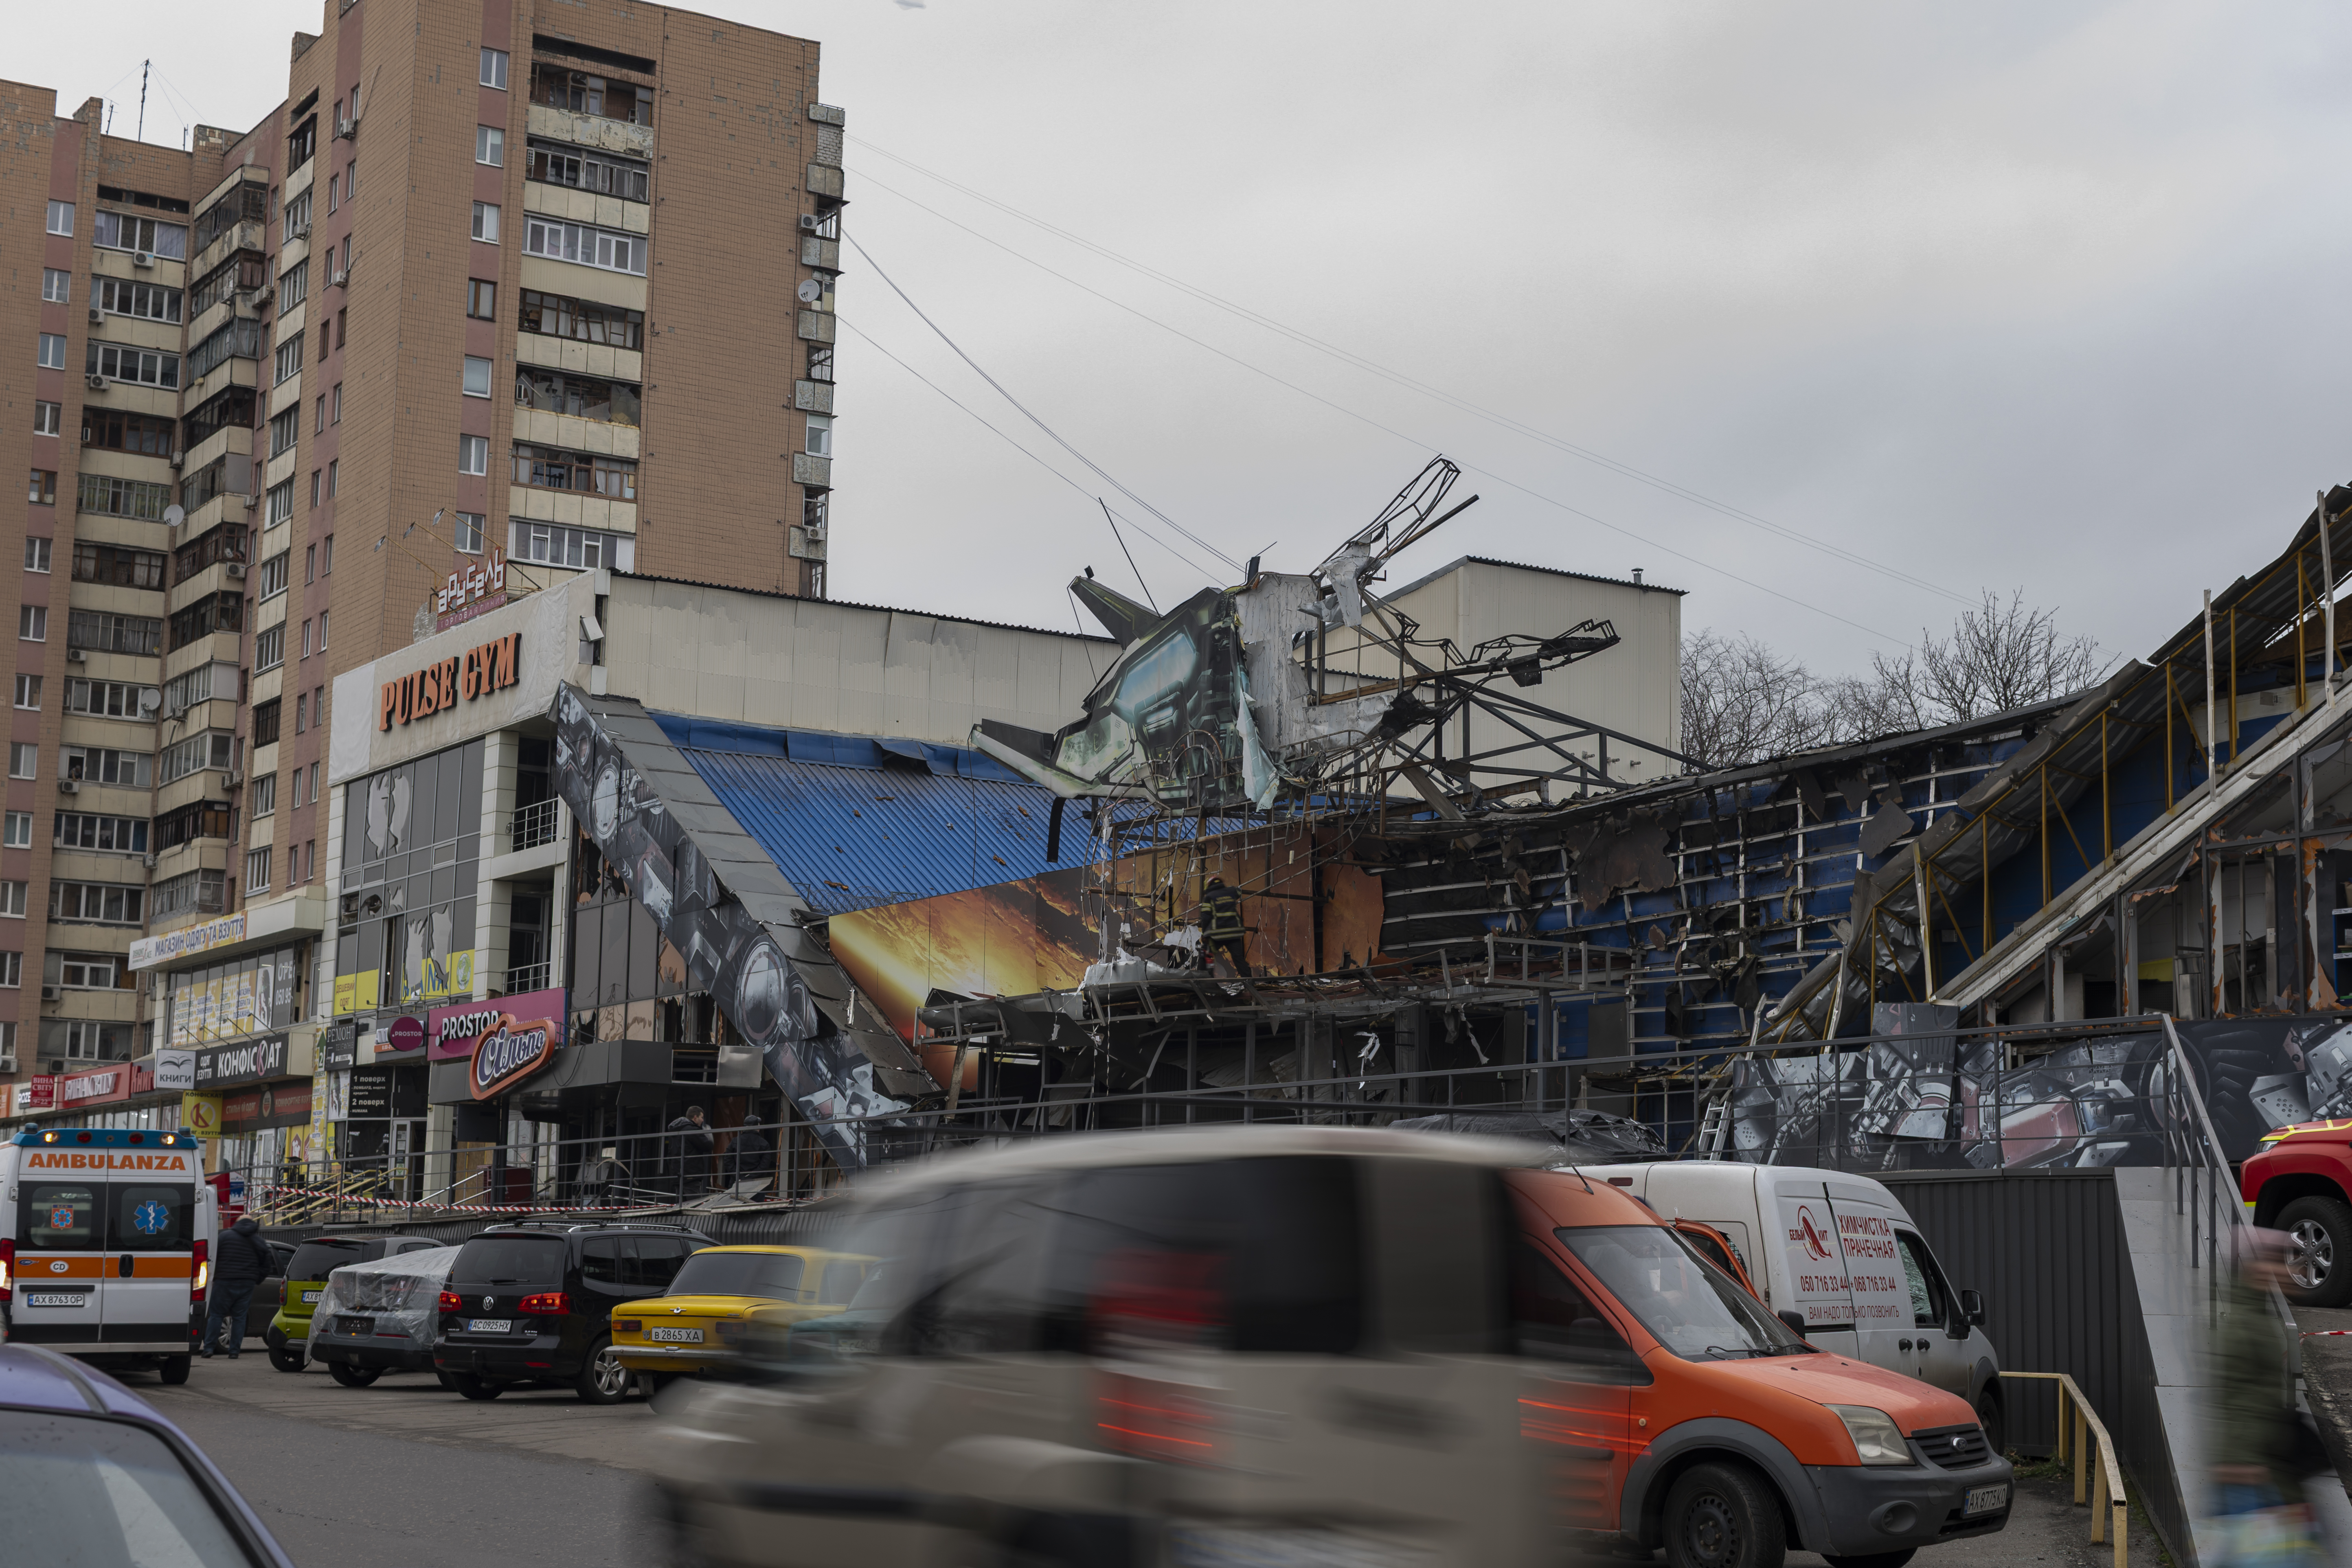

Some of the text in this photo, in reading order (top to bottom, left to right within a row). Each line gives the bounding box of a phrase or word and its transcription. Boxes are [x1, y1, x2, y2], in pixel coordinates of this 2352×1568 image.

[440, 606, 478, 628] ТОРГОВАЯ
[379, 632, 522, 732] PULSE GYM
[155, 917, 244, 957] МАГАЗИН ОДЯГУ ТА ВЗУТТЯ
[336, 980, 355, 995] ДЕШЕВИЙ
[275, 988, 285, 1006] 050
[339, 997, 350, 1008] ОДЯГ
[327, 1025, 355, 1043] РЕМОНТ
[200, 1055, 211, 1068] ОДЯГ
[217, 1040, 282, 1077] КОНФІСКАТ
[477, 1026, 545, 1086] Сільпо
[160, 1074, 191, 1083] КНИГИ
[196, 1068, 212, 1081] ВЗУТТЯ
[28, 1153, 186, 1171] AMBULANZA
[1789, 1227, 1828, 1241] БЕЛЫЙ КИТ
[1837, 1214, 1891, 1237] ХИМЧИСТКА
[1843, 1237, 1896, 1259] ПРАЧЕЧНАЯ
[1800, 1275, 1896, 1292] 050 716 33 44 068 716 33 44
[70, 1296, 83, 1304] OP
[1809, 1305, 1899, 1321] ВАМ НАДО ТОЛЬКО ПОЗВОНИТЬ
[472, 1321, 510, 1330] AC 0925 HX
[662, 1330, 682, 1340] 2865
[685, 1330, 700, 1341] ХА
[1968, 1487, 2006, 1510] AX 8775 KO
